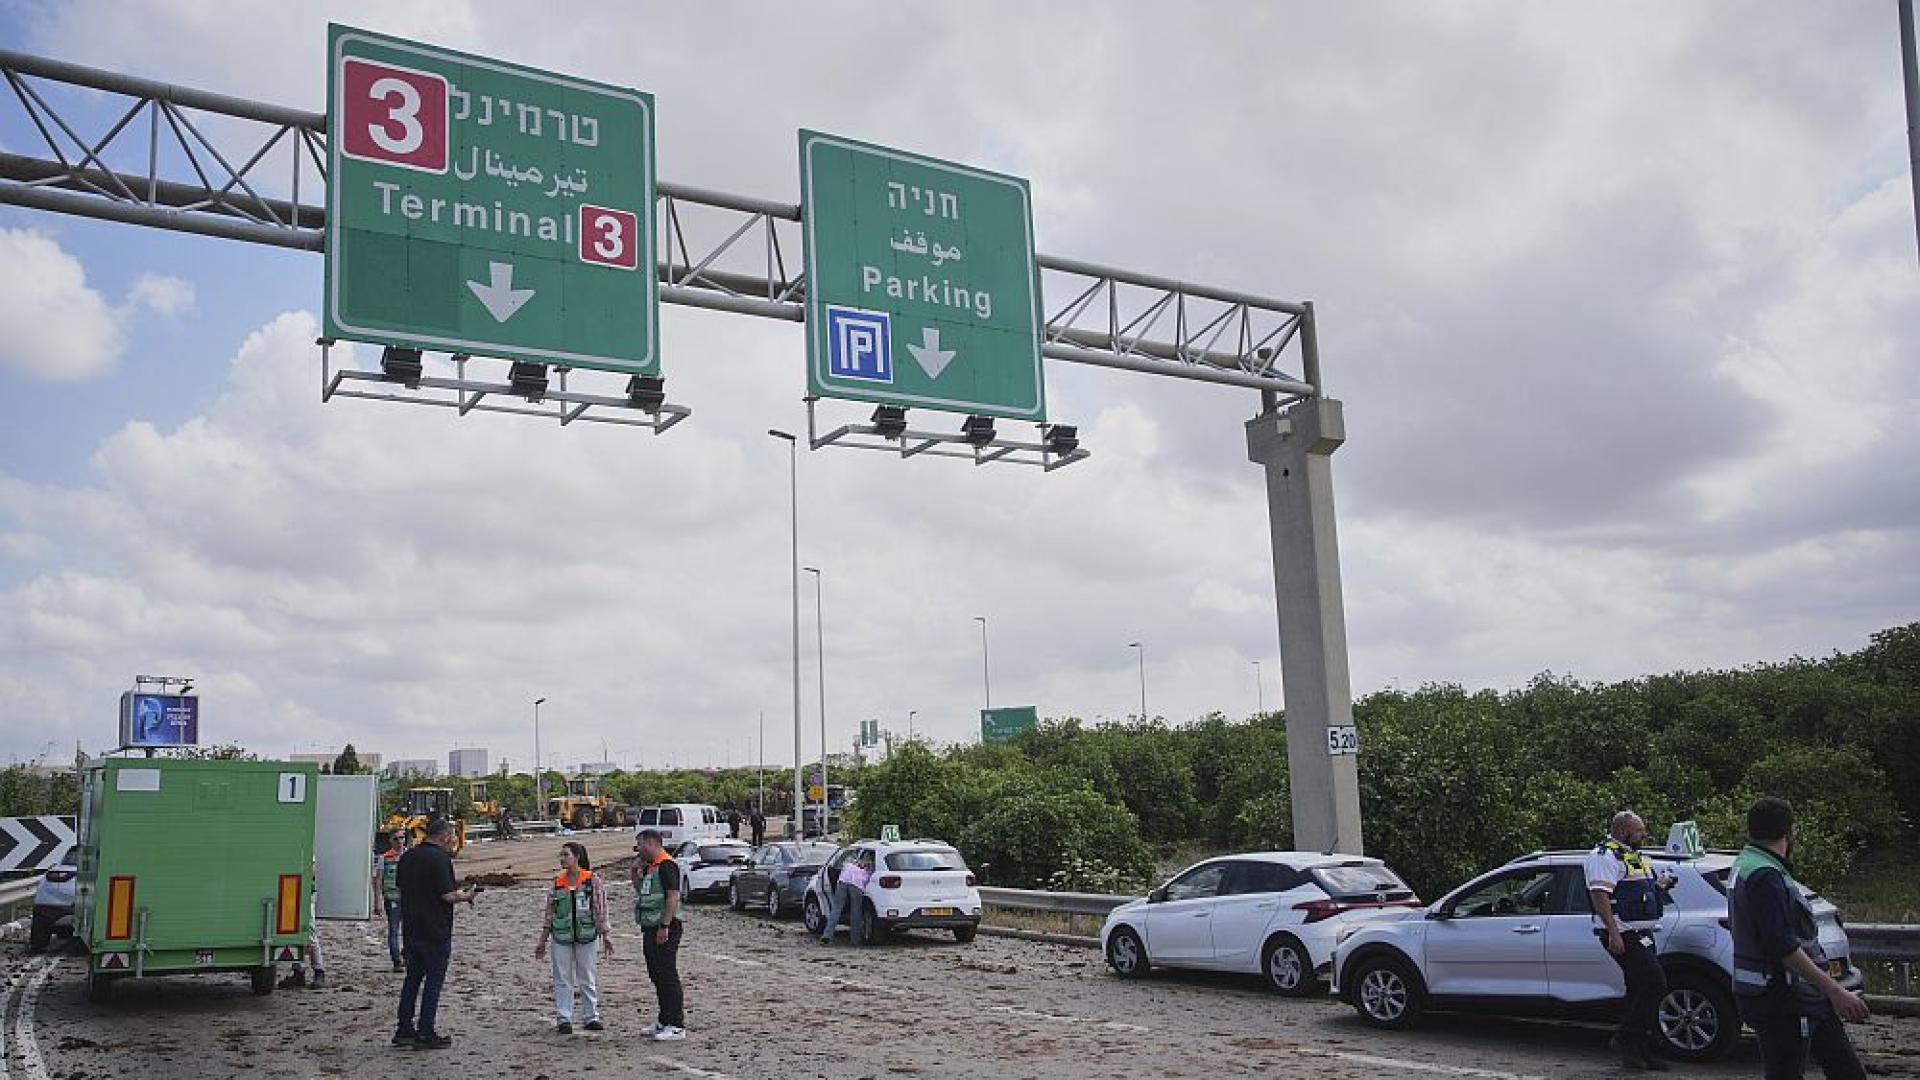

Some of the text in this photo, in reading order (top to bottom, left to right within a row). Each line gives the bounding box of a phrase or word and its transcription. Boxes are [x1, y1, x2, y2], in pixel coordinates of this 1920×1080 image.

[368, 78, 423, 154] 3
[450, 84, 599, 147] טרמינל
[372, 181, 623, 258] Terminal 3
[888, 181, 959, 219] חניה
[891, 229, 960, 266] موقف
[863, 266, 992, 318] Parking
[289, 776, 296, 799] 1
